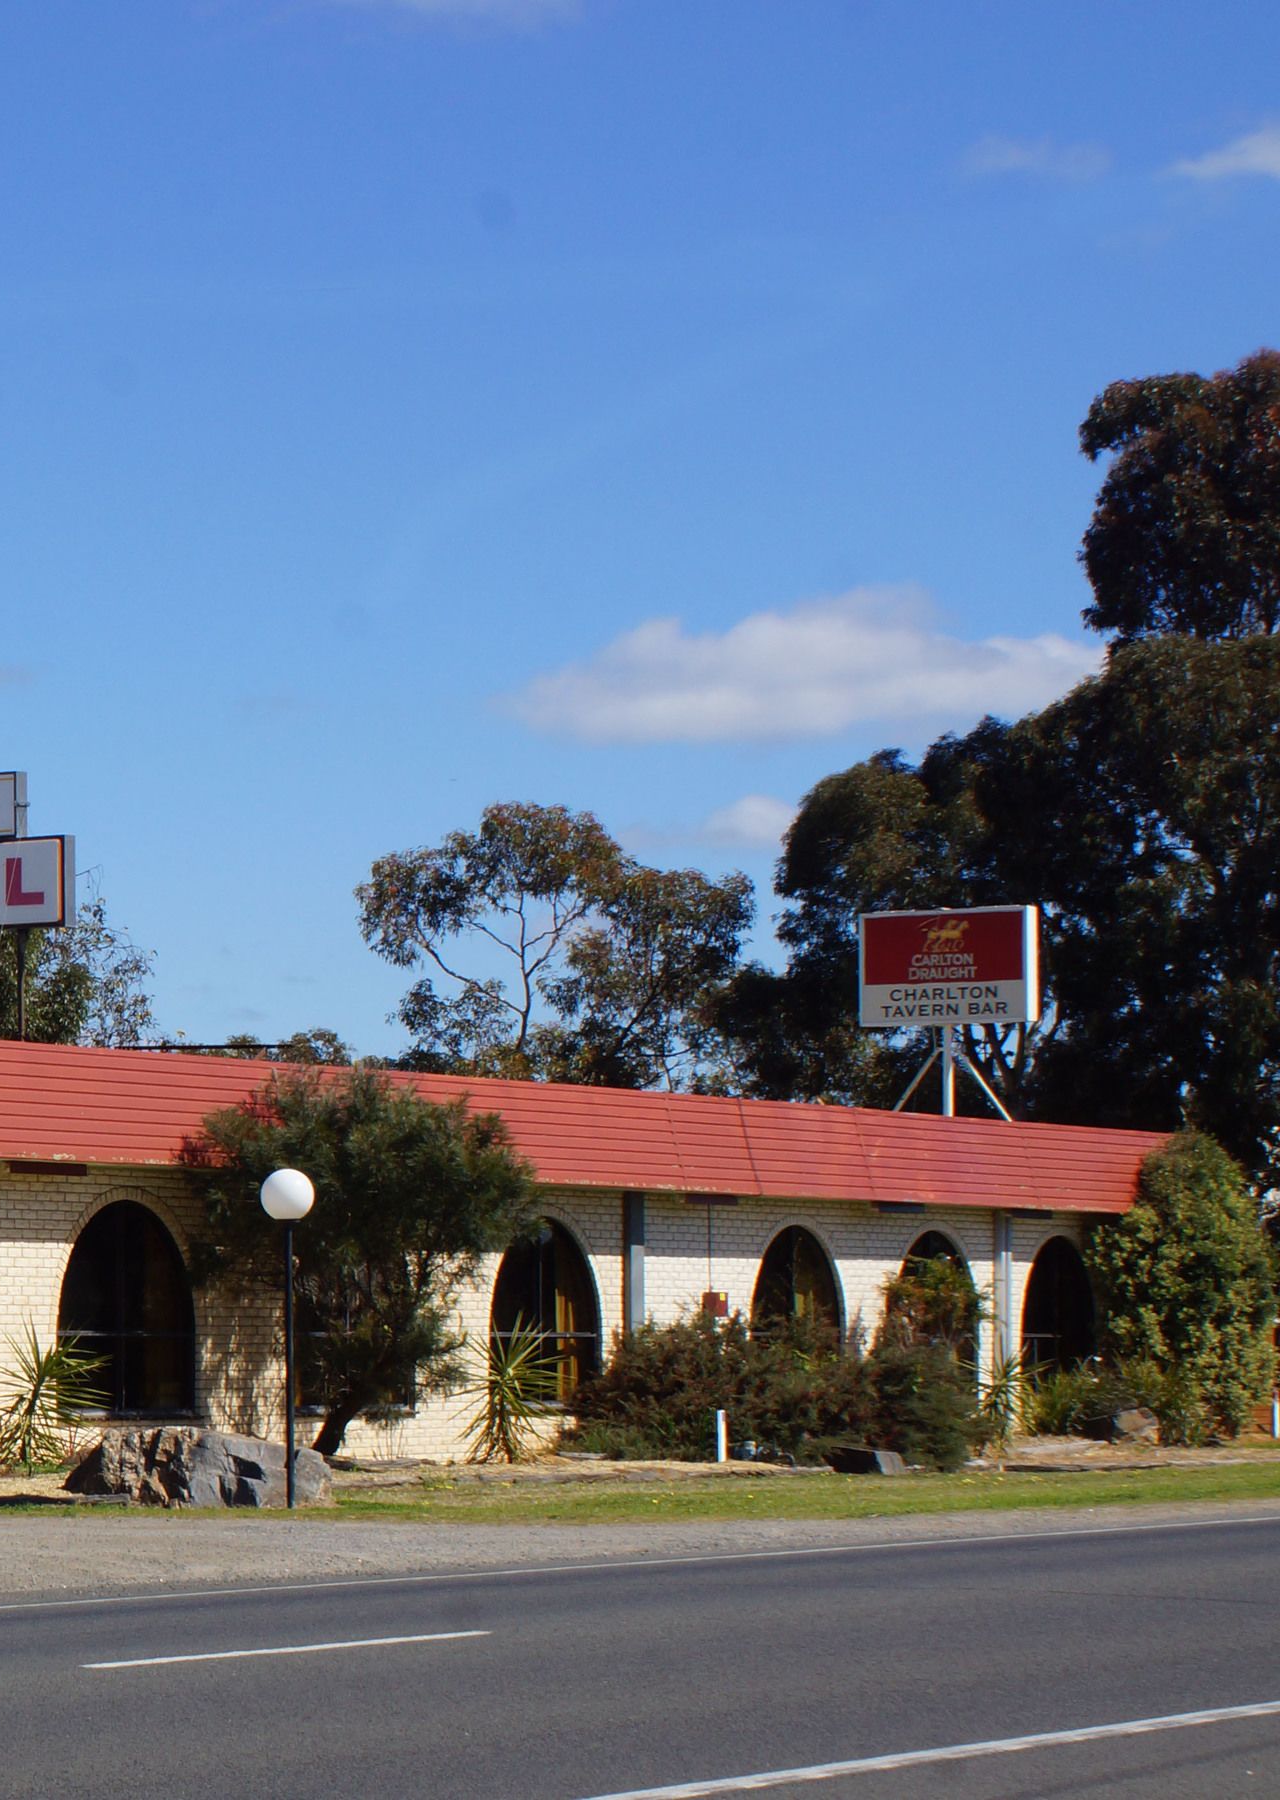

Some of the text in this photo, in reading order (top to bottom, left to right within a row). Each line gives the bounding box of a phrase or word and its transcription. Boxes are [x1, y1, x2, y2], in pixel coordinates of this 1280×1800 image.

[912, 954, 974, 966] CARLTON
[909, 967, 978, 979] DRAUGHT
[890, 986, 998, 1001] CHARLTON
[881, 1002, 1008, 1018] TAVERN BAR
